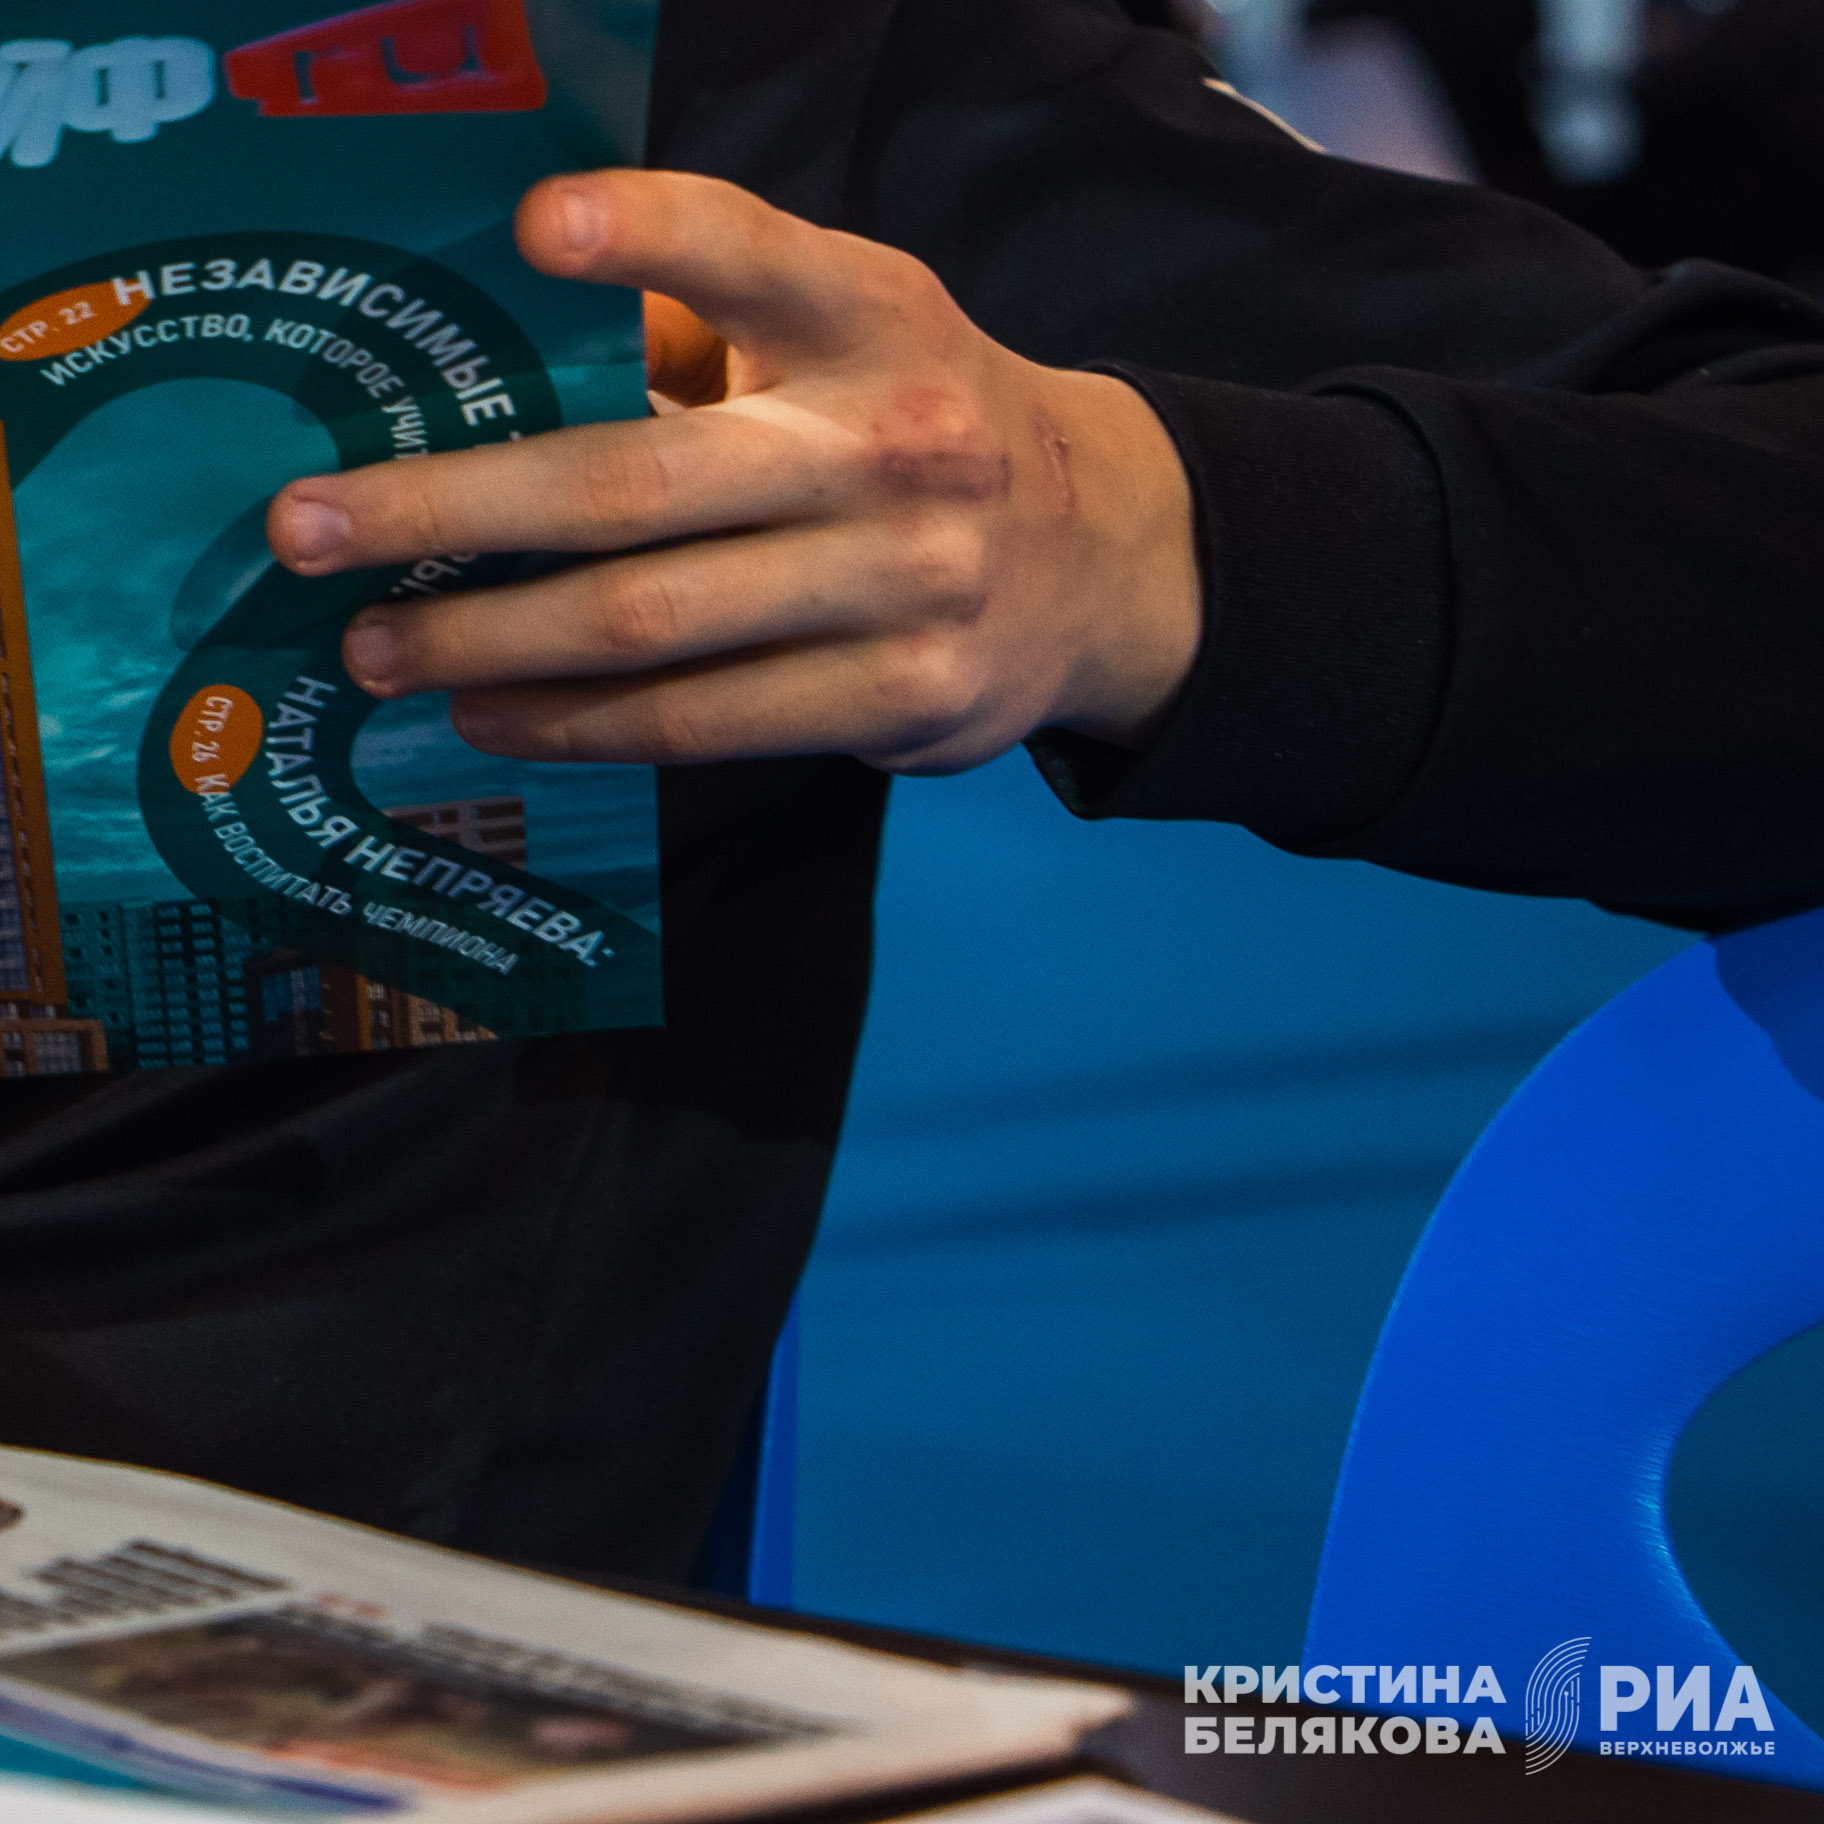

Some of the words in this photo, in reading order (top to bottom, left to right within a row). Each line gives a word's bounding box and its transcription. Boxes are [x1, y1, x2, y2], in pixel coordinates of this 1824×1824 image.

[0, 319, 60, 353] СТР.
[58, 300, 97, 326] 22
[39, 312, 254, 387] ИСКУССТВО,
[264, 317, 405, 401] КОТОРОЕ
[110, 257, 517, 426] НЕЗАВИСИМЫЕ
[191, 740, 221, 764] 26
[194, 695, 235, 737] СТР.
[195, 773, 241, 823] КАК
[265, 676, 361, 850] НАТАЛЬЯ
[342, 834, 616, 969] НЕПРЯЕВА:
[213, 821, 353, 917] ВОСПИТАТЬ
[361, 900, 520, 976] ЧЕМПИОНА
